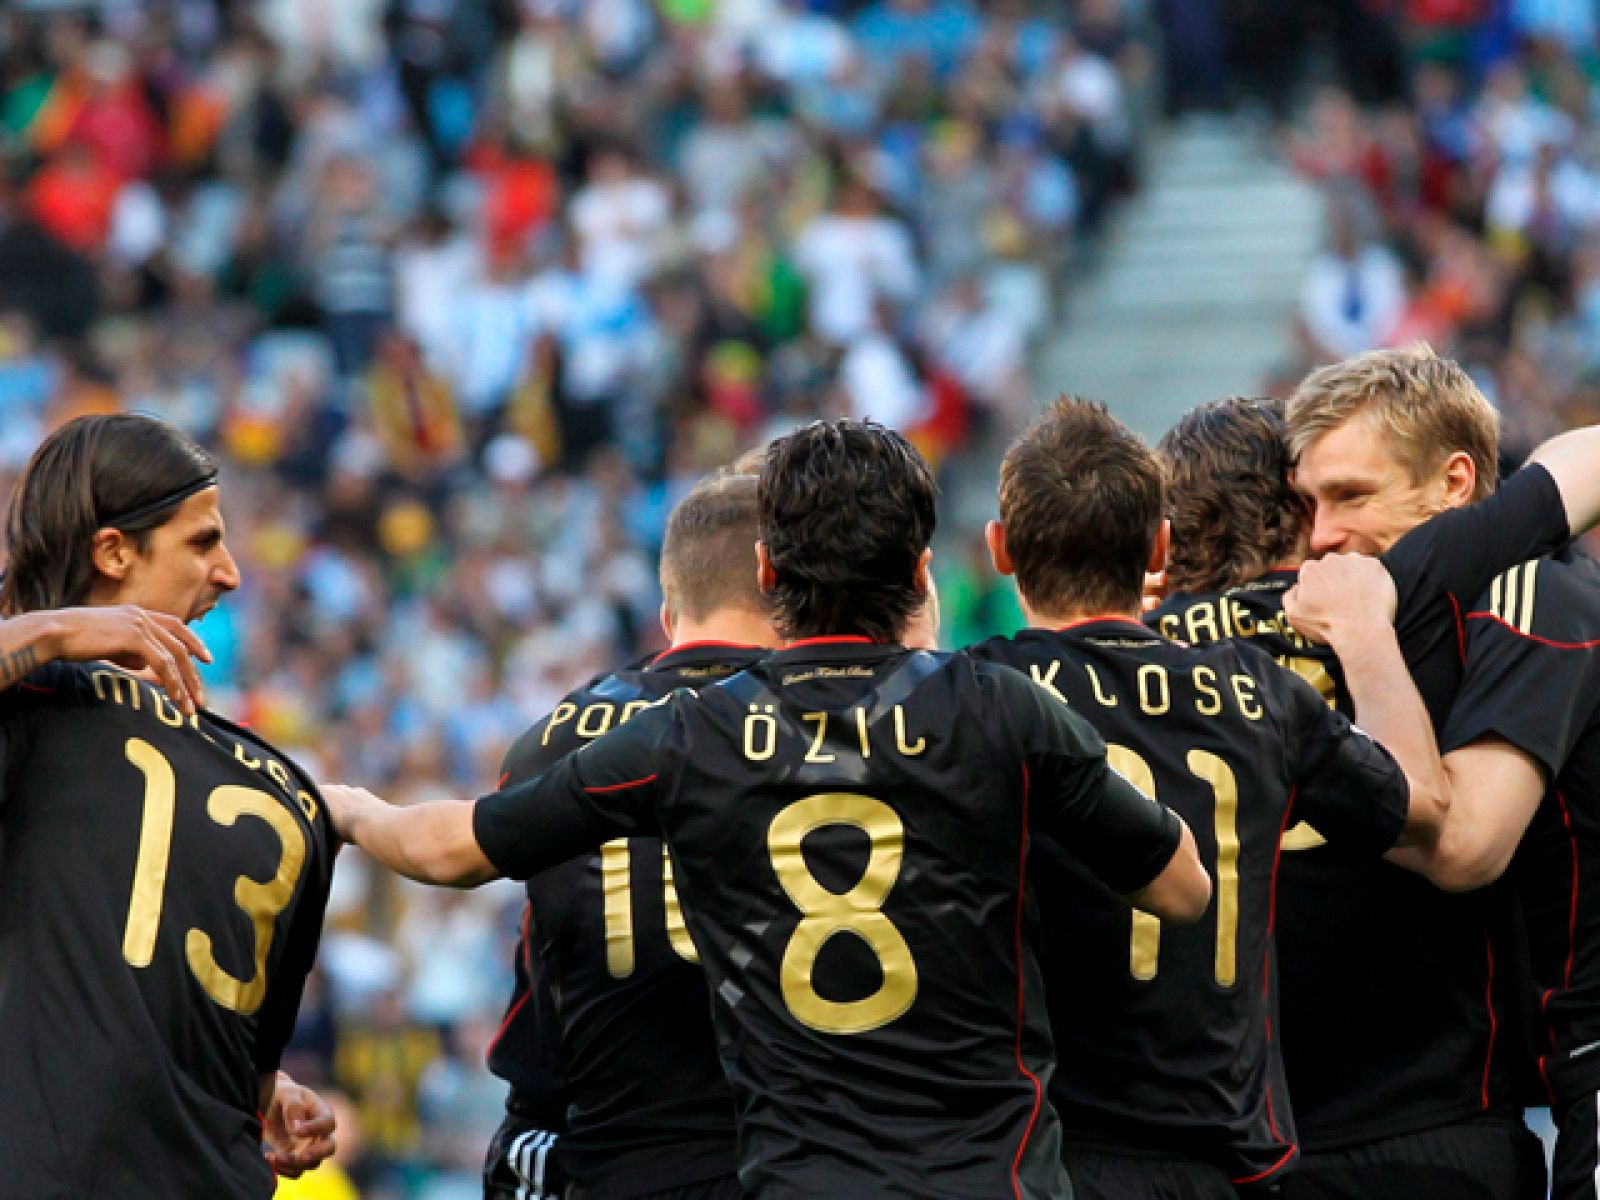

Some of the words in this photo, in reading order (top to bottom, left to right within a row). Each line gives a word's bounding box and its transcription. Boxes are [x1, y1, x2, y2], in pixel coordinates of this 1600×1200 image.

[743, 704, 926, 763] ÖZIL
[1030, 660, 1263, 720] KLOSE
[122, 737, 306, 1016] 13
[602, 836, 699, 979] 1
[767, 792, 919, 1035] 8
